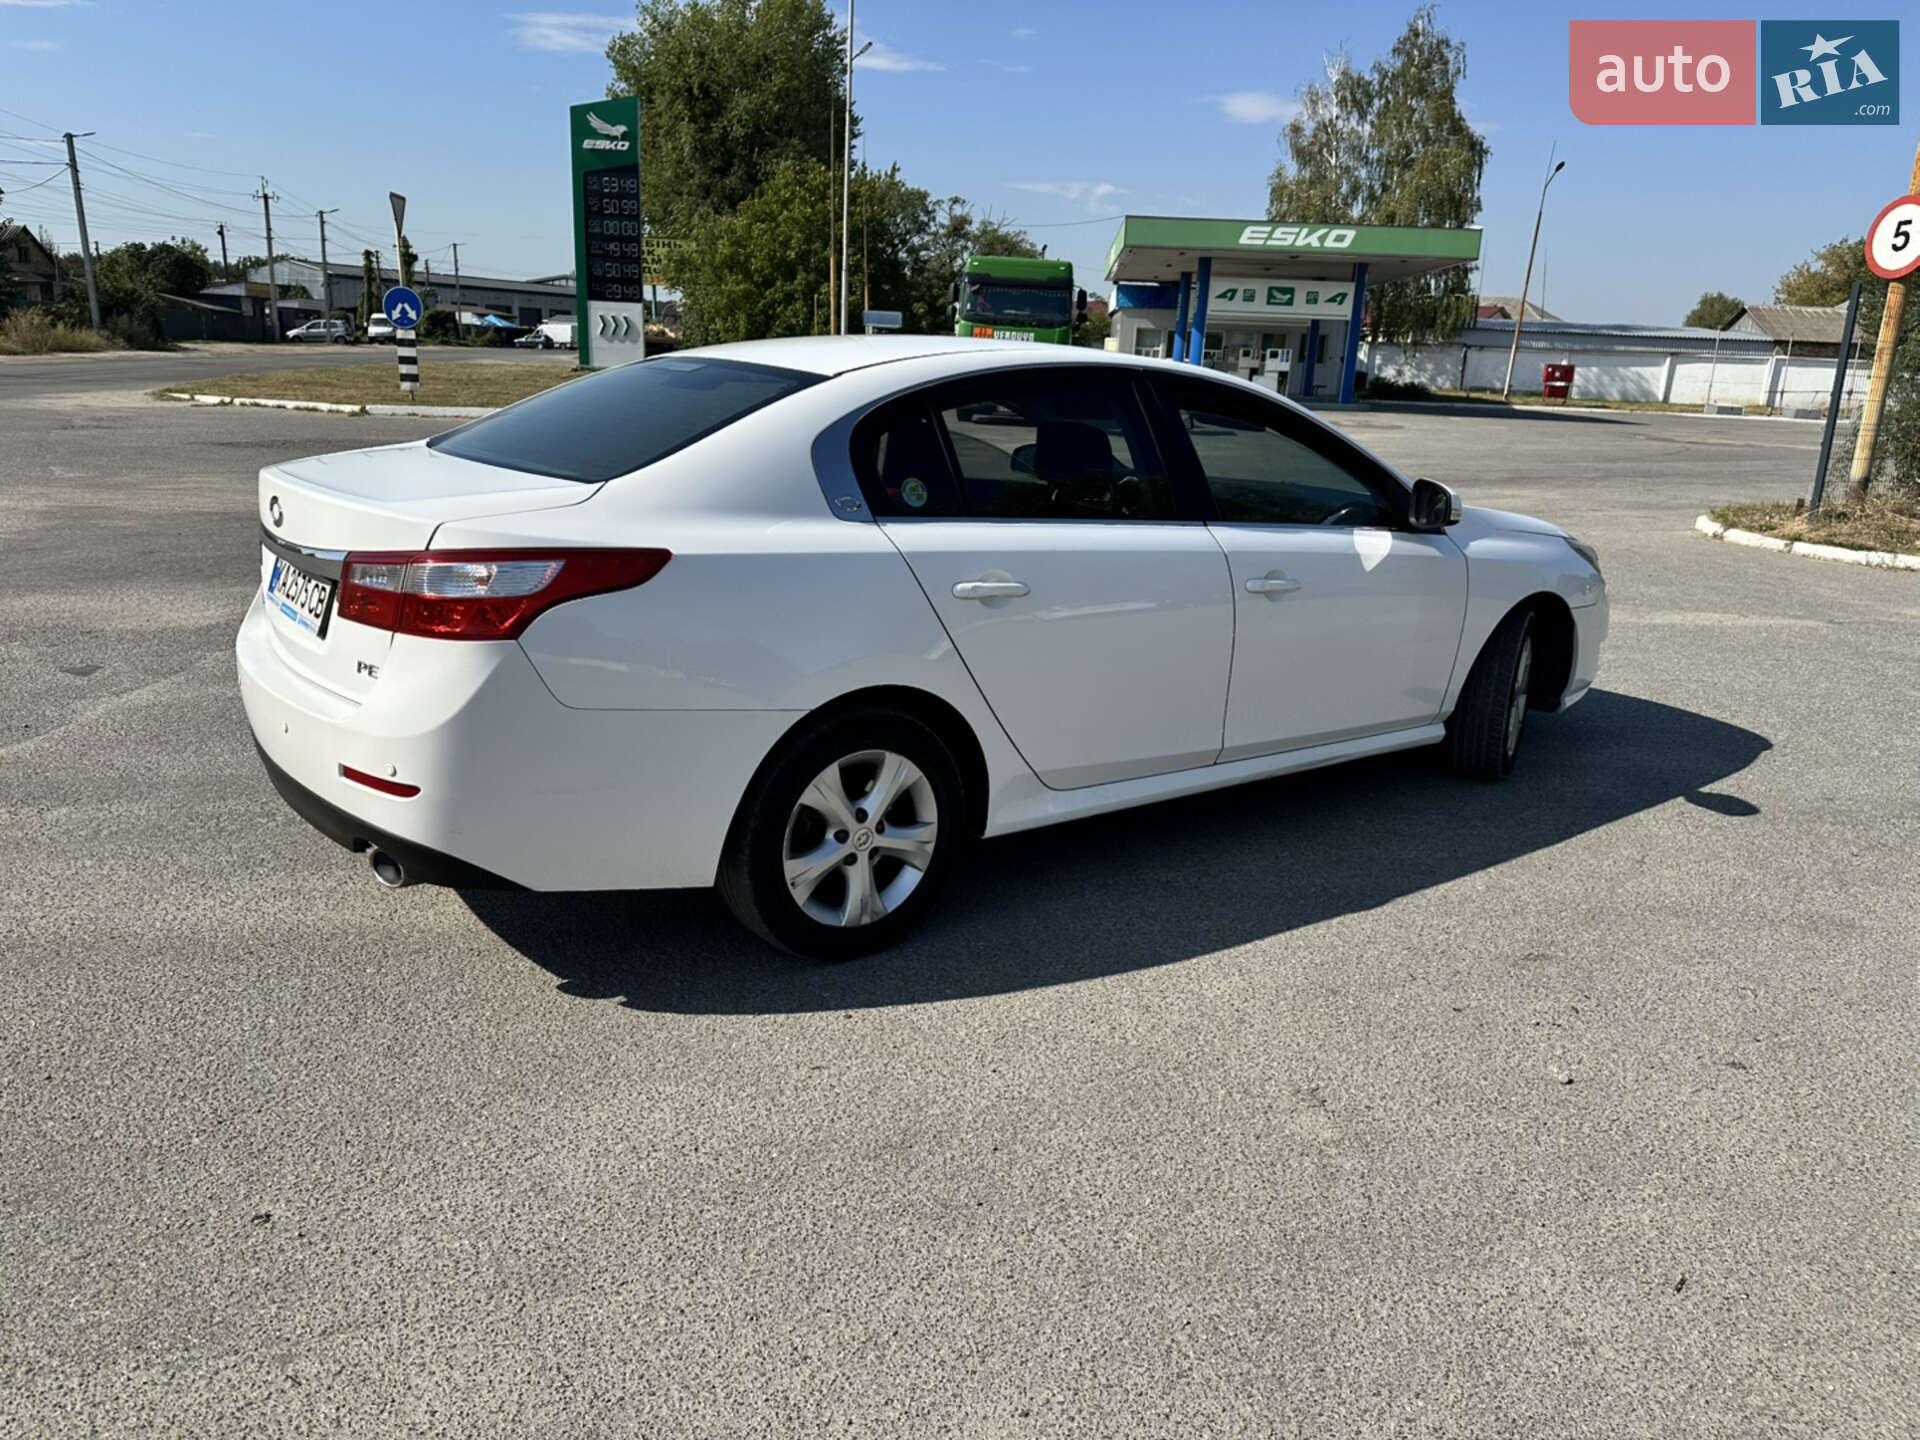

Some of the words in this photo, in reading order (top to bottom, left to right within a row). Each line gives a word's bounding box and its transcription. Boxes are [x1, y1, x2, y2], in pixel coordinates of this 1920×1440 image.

[582, 139, 630, 151] ESKO
[1239, 226, 1357, 248] ESKO
[1891, 219, 1913, 252] 5
[357, 660, 379, 680] PE
